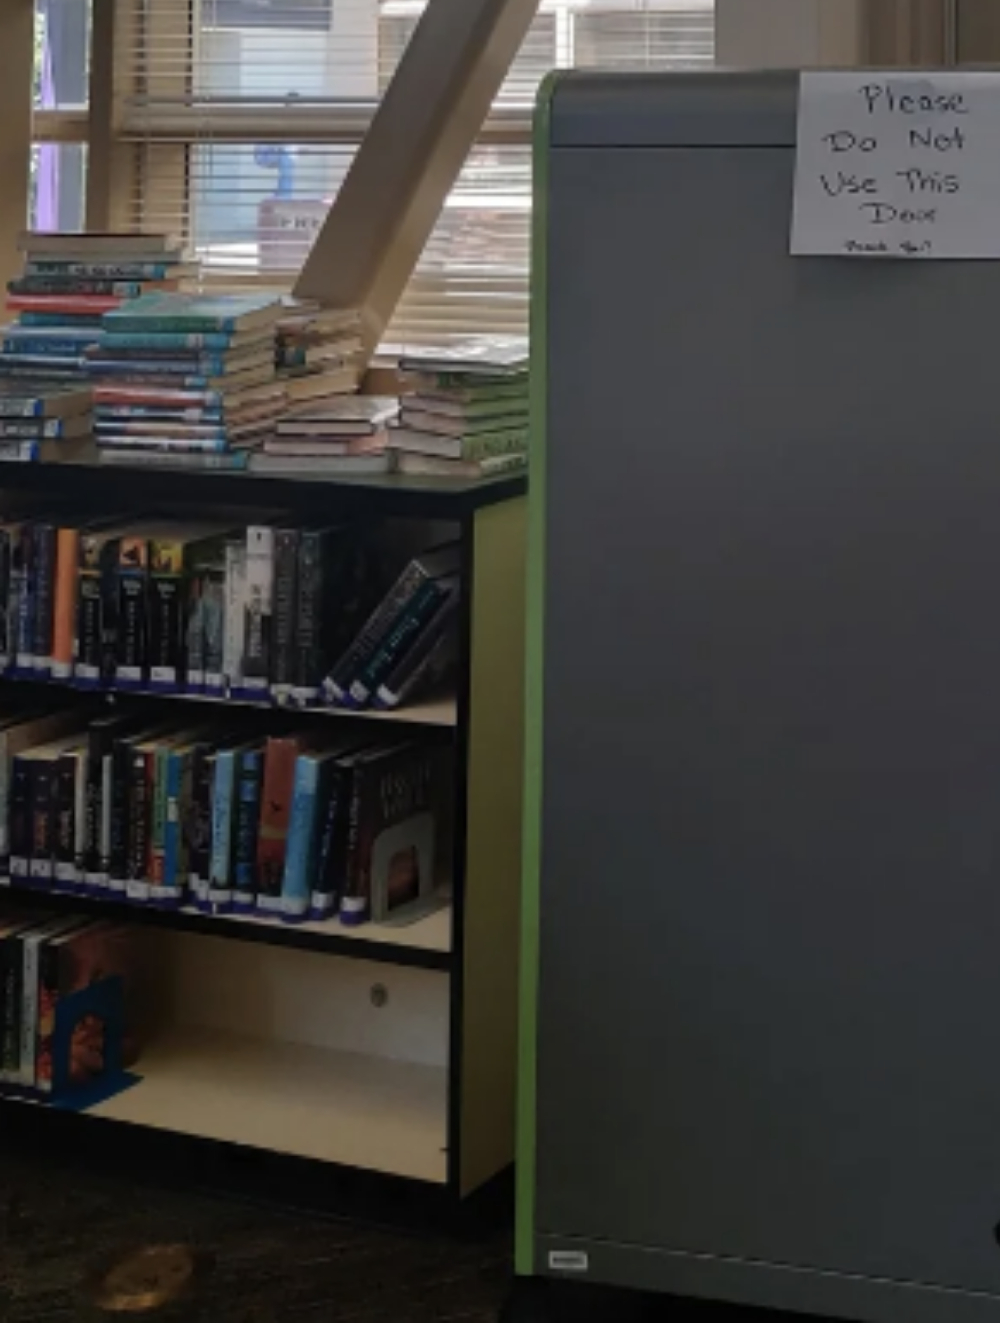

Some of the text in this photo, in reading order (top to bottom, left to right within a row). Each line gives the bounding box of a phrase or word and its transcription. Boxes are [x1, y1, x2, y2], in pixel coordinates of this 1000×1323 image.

[858, 84, 969, 115] Please
[821, 126, 965, 153] Do Not
[820, 167, 961, 197] Use This
